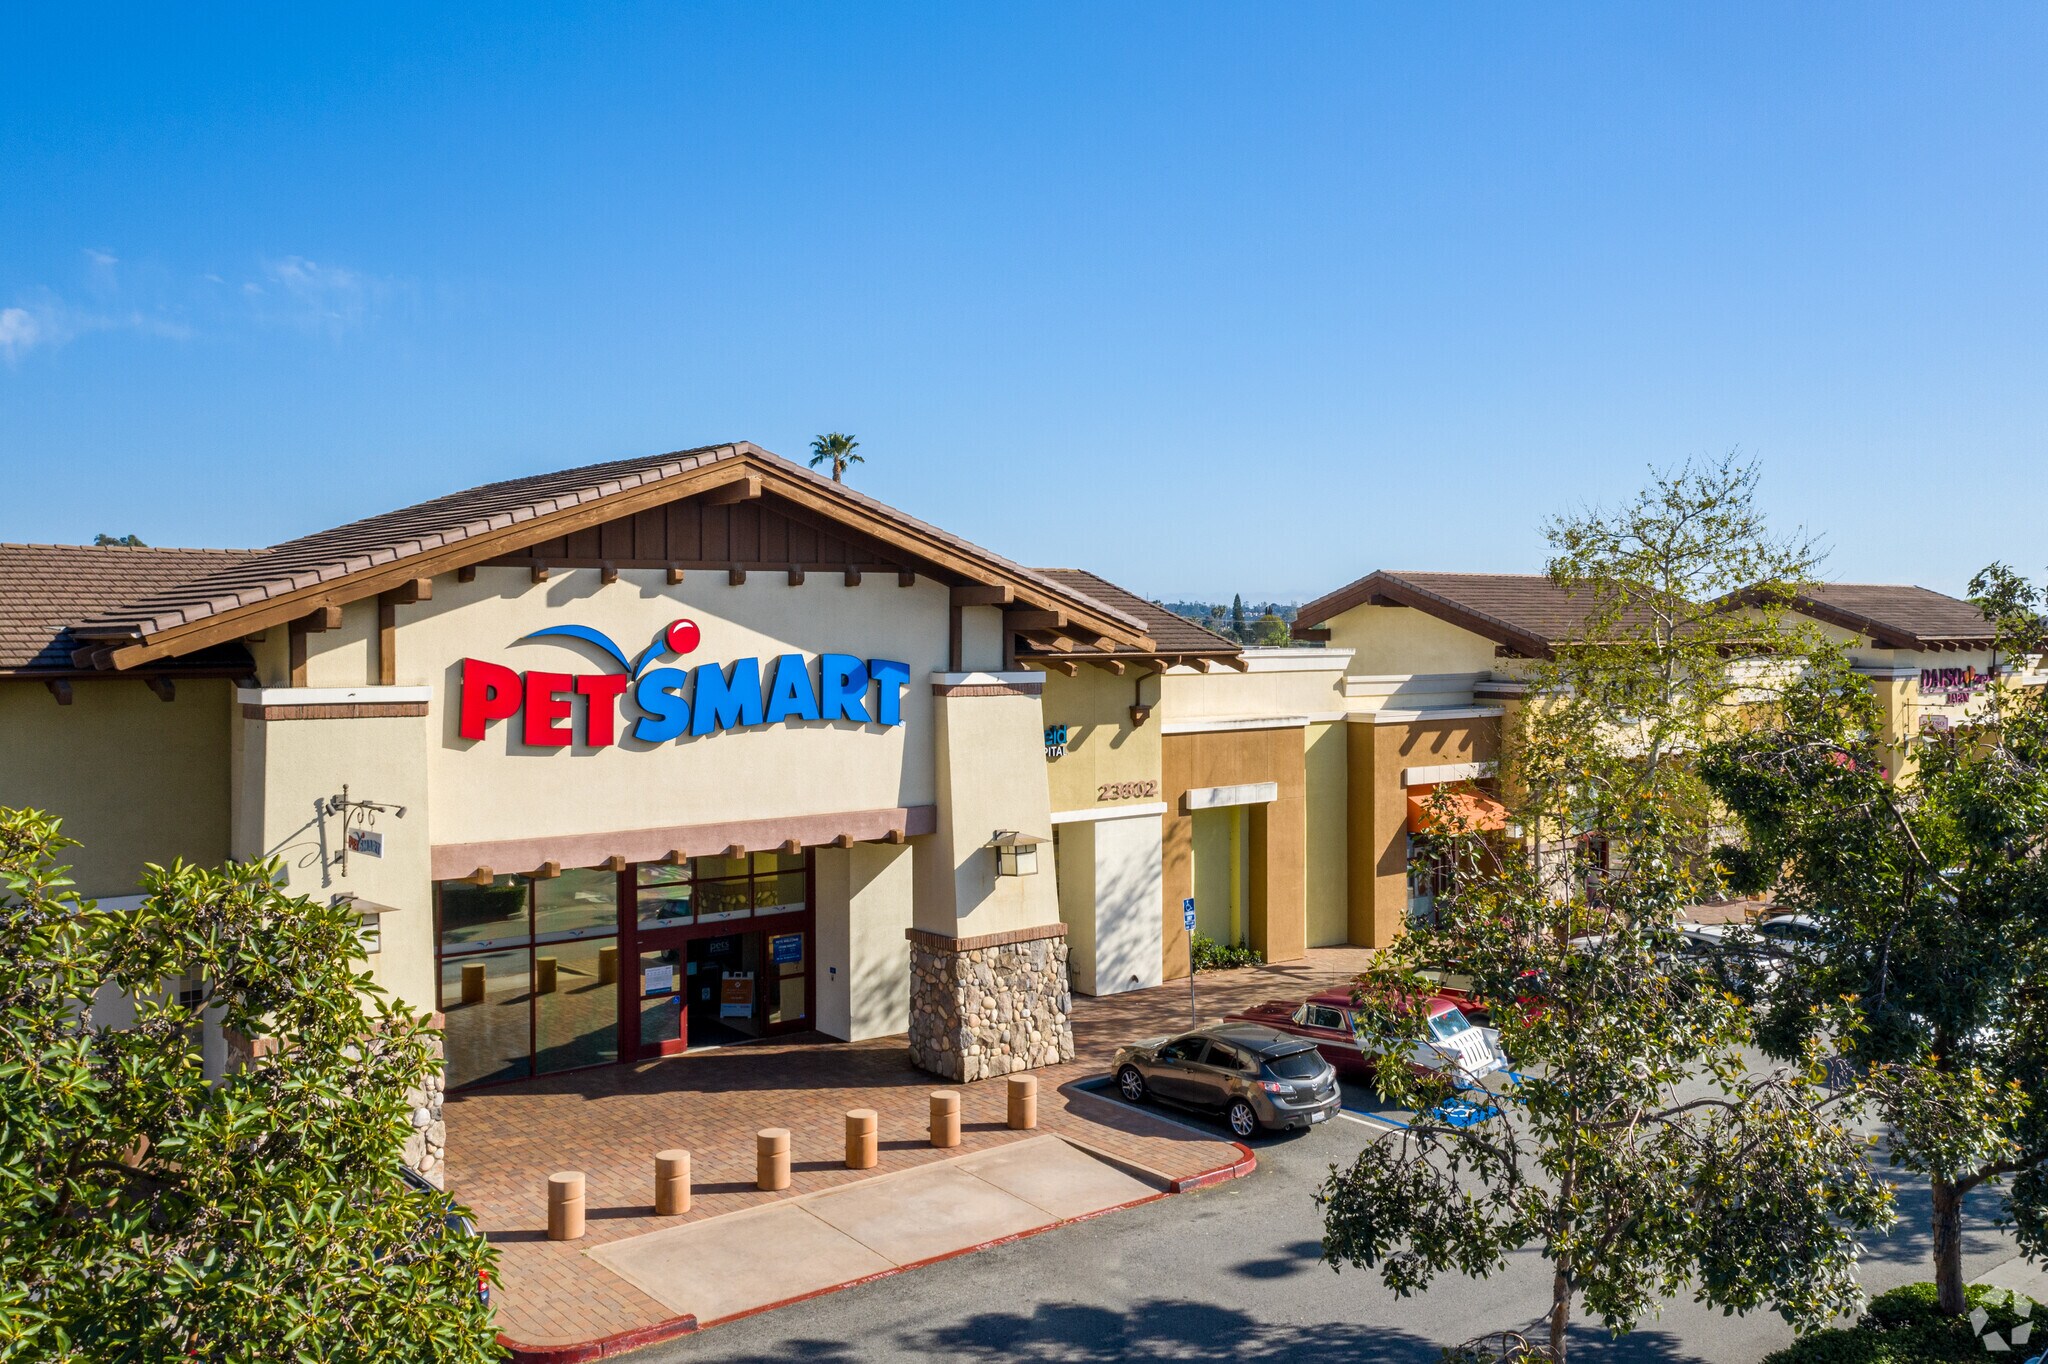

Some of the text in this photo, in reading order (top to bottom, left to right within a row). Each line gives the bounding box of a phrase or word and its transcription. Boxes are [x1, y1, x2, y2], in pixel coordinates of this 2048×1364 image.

[1920, 668, 1963, 688] DAISO
[1947, 692, 1970, 704] JAPAN
[1097, 780, 1158, 802] 23602
